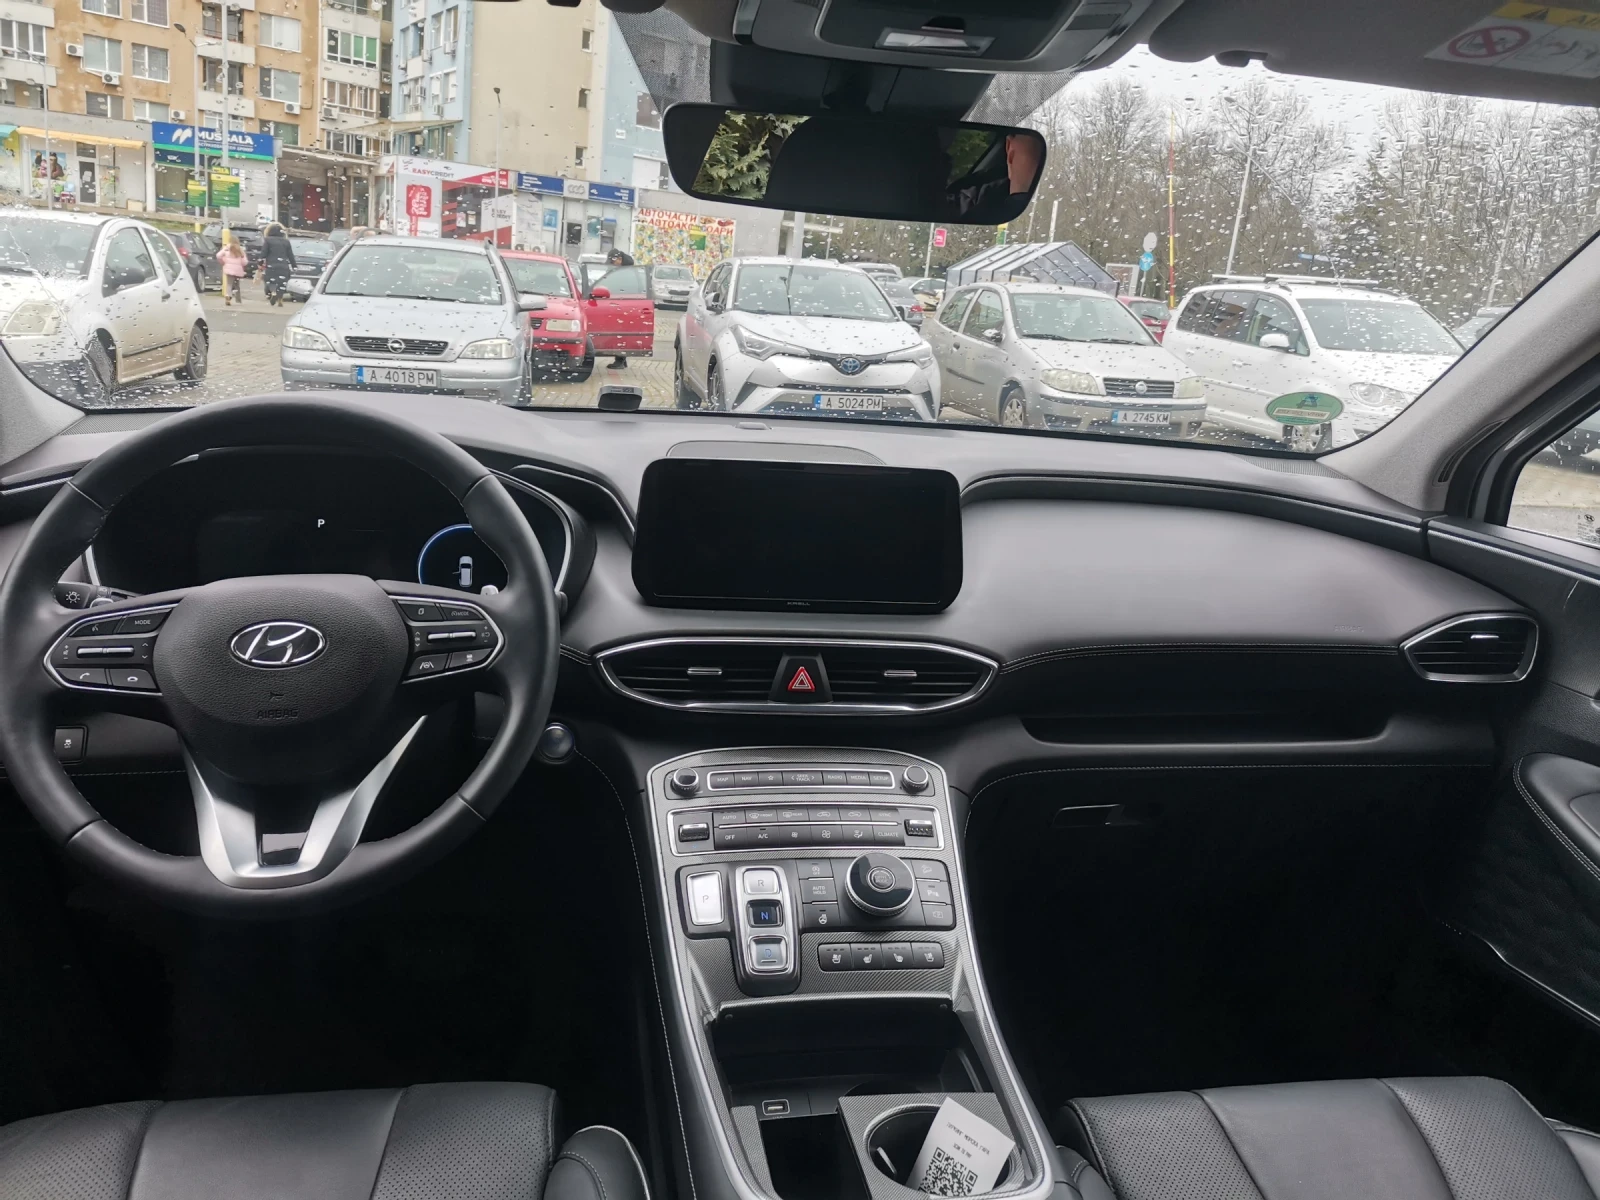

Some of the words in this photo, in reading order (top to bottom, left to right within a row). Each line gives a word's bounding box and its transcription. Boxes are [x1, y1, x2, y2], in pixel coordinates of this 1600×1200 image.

[412, 168, 454, 178] EASYCREDIT
[638, 208, 697, 222] АВТОЧАСТИ
[648, 218, 734, 236] АВТОАКСОАРИ
[317, 519, 325, 528] P
